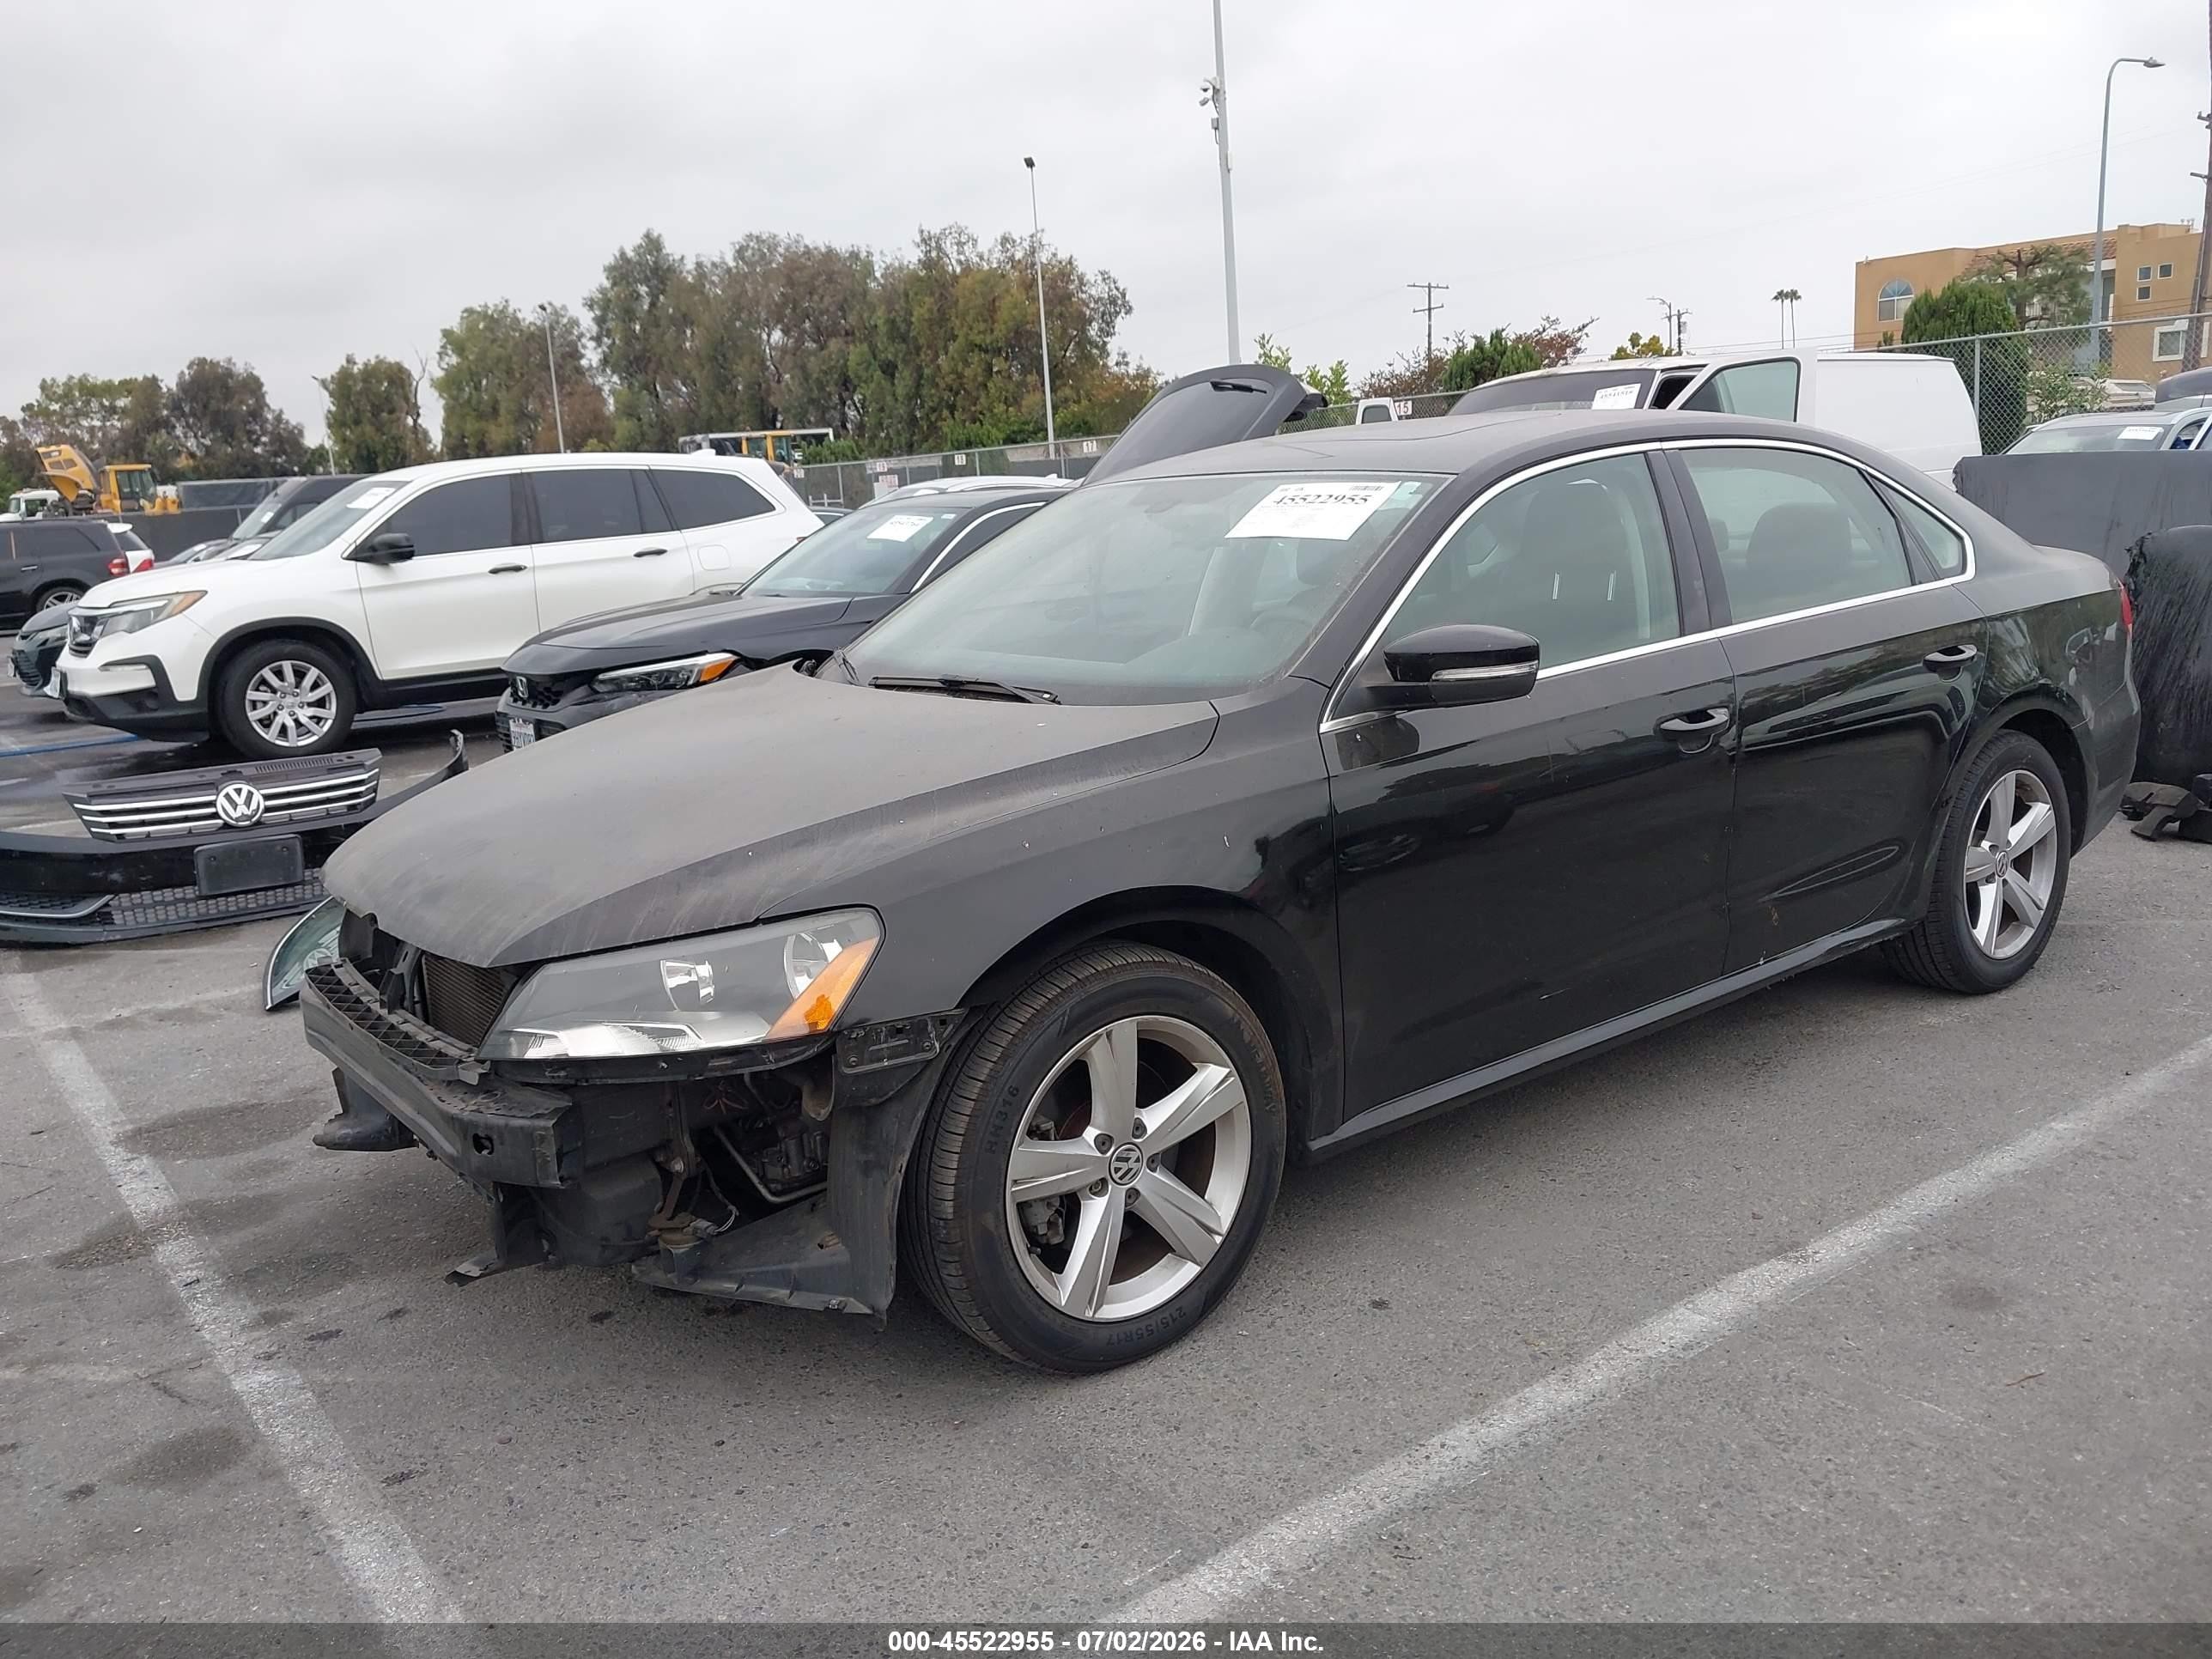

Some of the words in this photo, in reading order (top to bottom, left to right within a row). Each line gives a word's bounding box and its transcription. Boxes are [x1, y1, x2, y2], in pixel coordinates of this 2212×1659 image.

[1396, 401, 1409, 414] 15
[1085, 440, 1095, 453] 17
[1273, 494, 1372, 505] 45522955
[1106, 1306, 1186, 1346] 215/55R17
